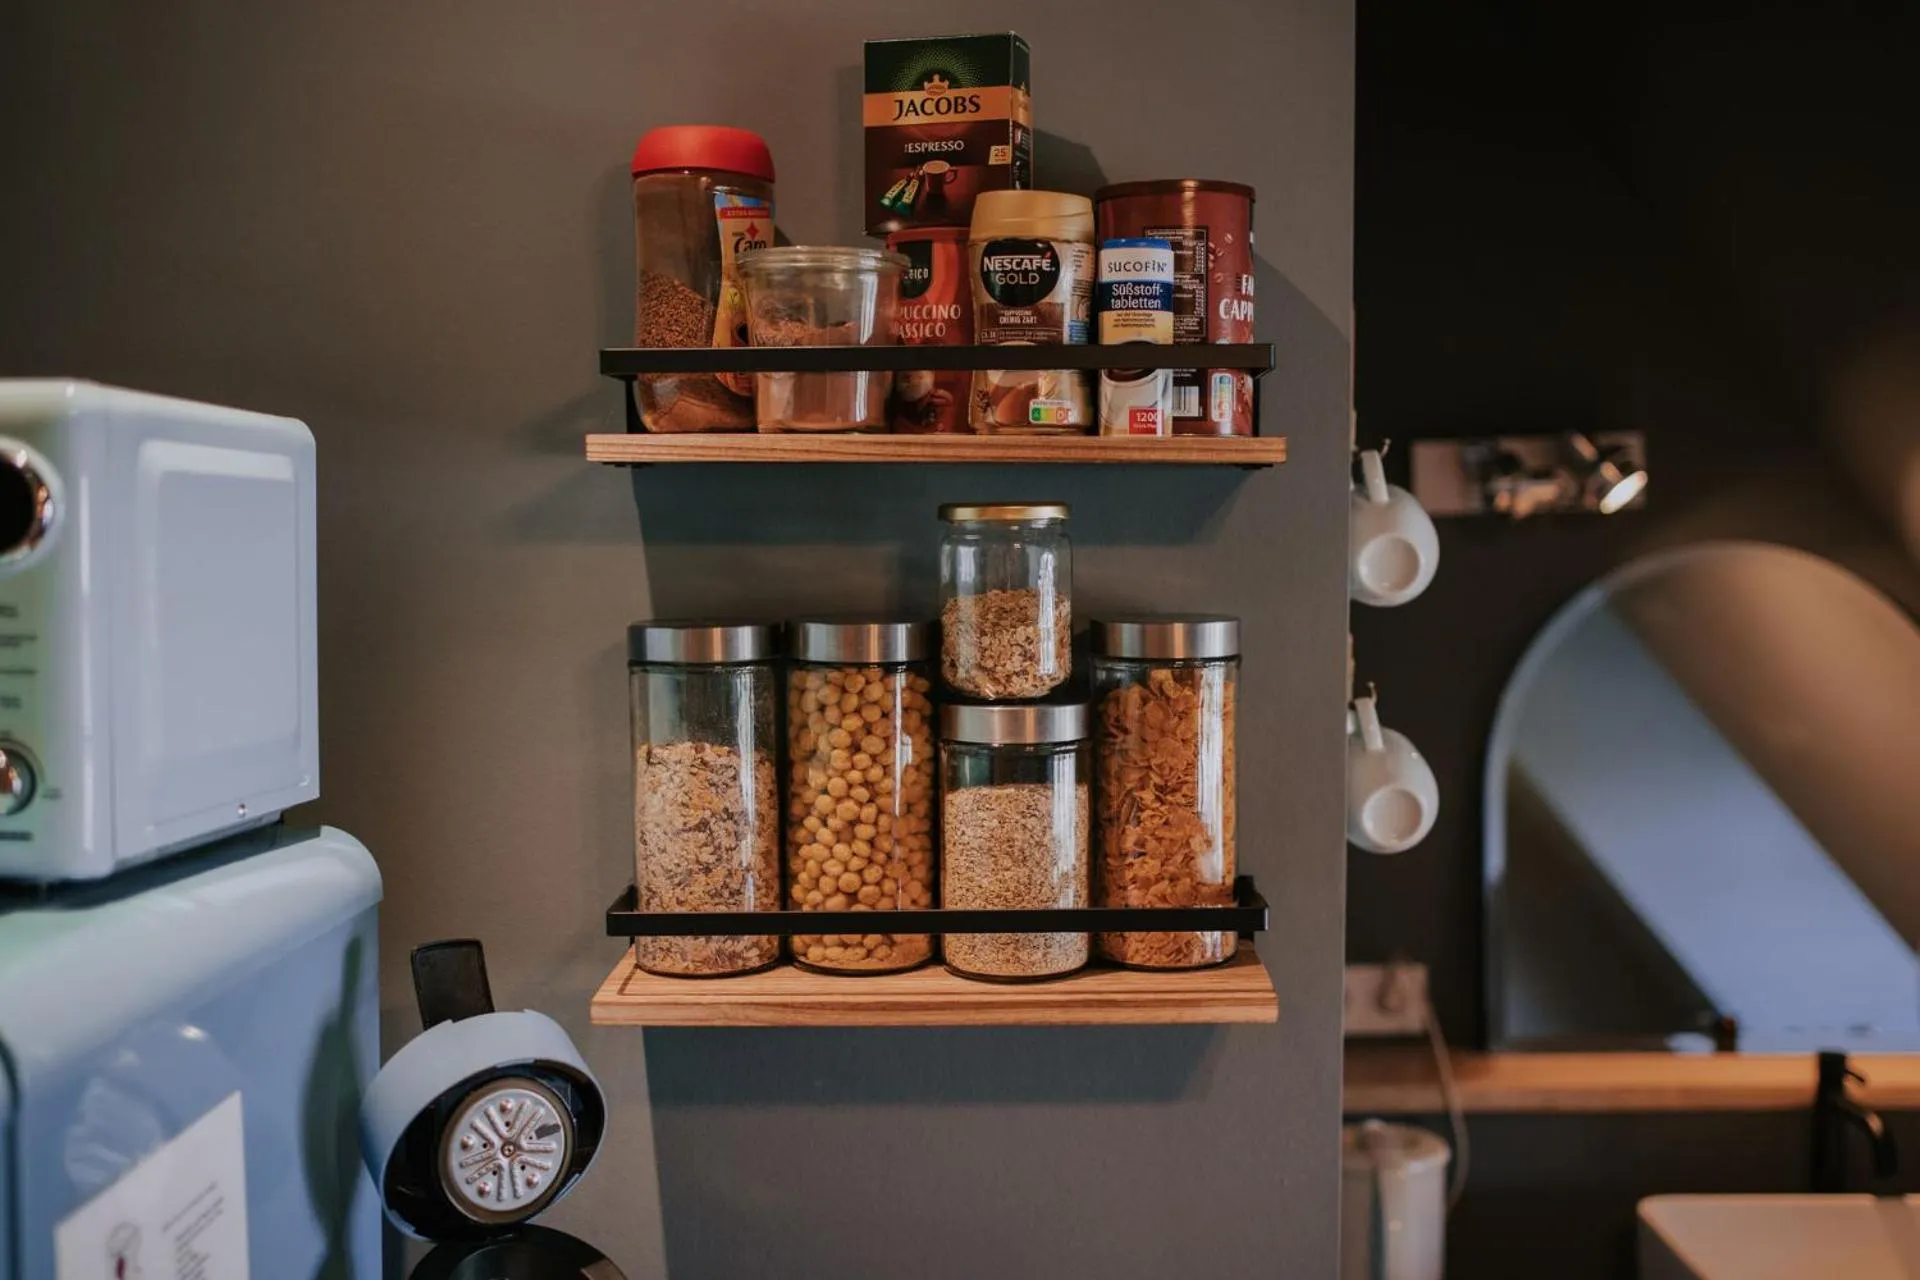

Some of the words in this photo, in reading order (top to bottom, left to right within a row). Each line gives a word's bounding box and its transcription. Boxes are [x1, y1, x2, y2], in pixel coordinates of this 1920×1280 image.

[893, 95, 981, 121] JACOBS
[908, 140, 965, 153] ESPRESSO
[995, 273, 1040, 285] GOLD
[1111, 297, 1161, 309] tabletten
